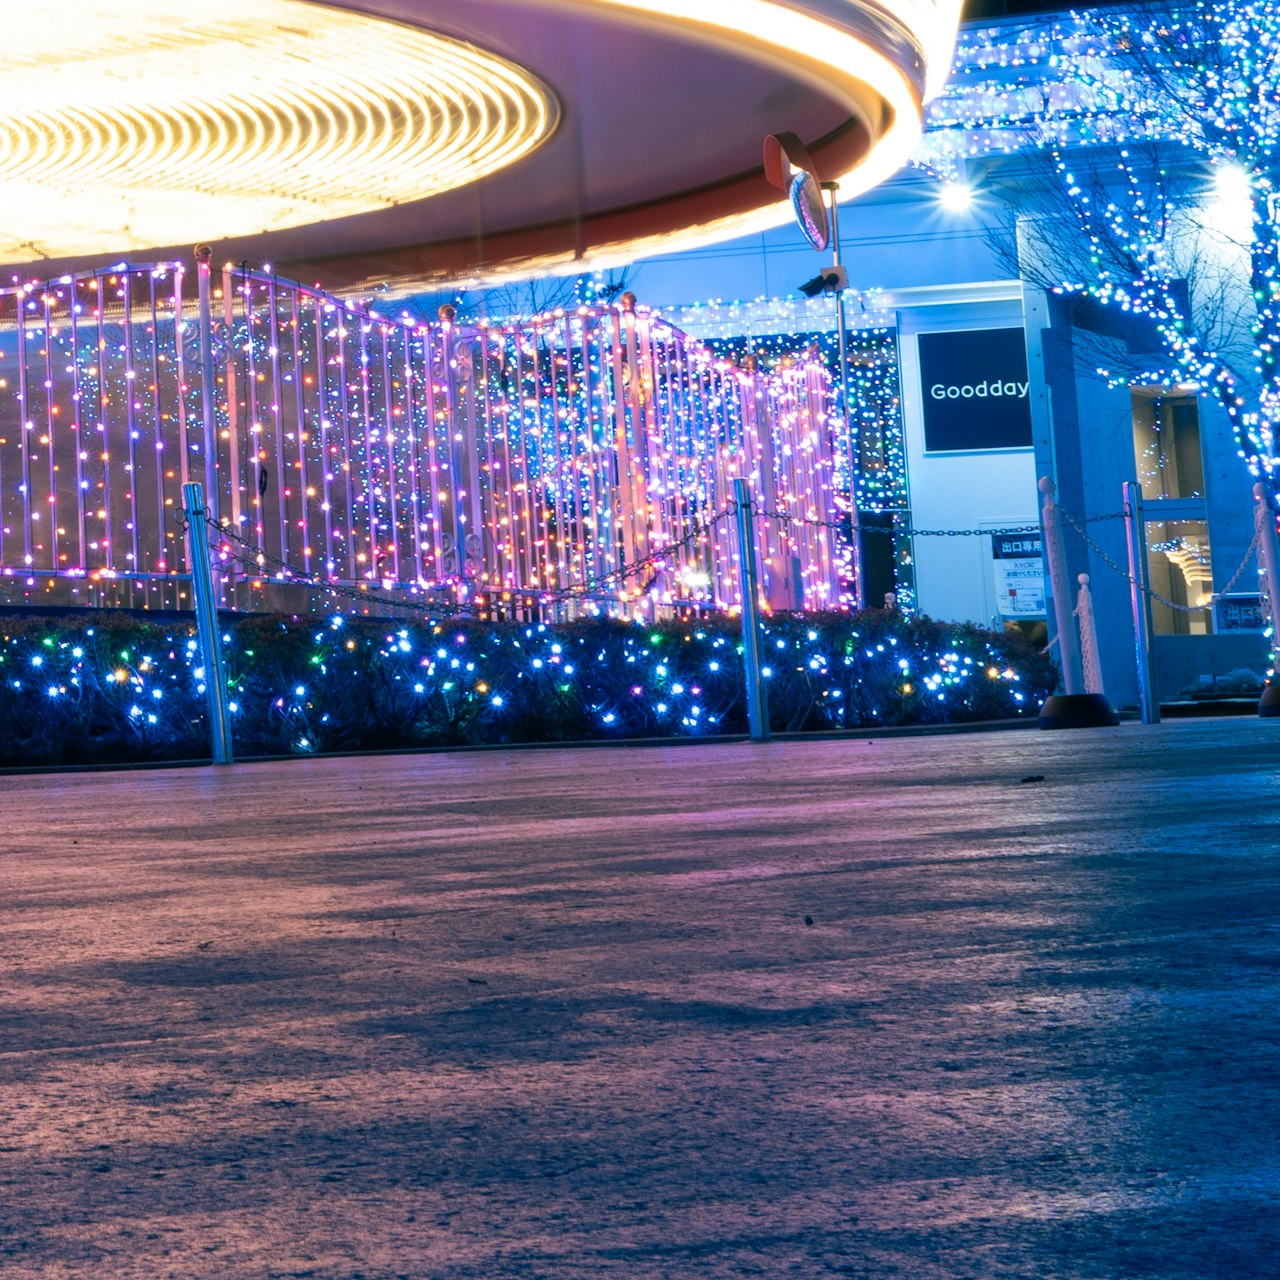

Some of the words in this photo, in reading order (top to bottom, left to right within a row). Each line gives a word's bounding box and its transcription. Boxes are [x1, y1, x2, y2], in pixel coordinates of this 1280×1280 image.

[931, 380, 1029, 399] Goodday
[1002, 540, 1042, 553] 出口専用
